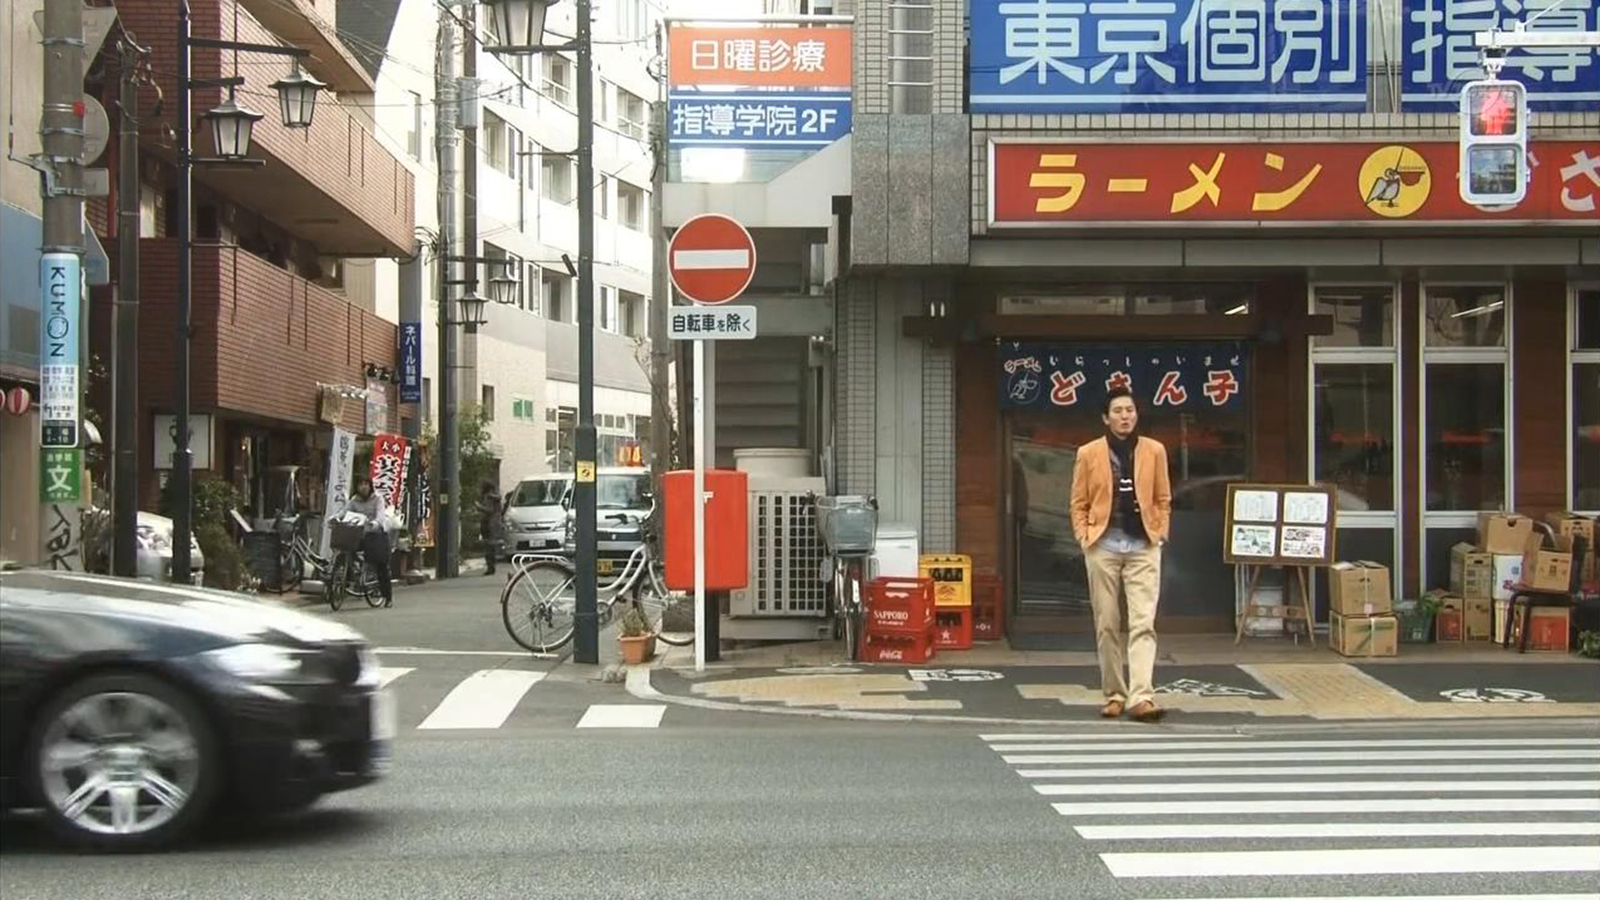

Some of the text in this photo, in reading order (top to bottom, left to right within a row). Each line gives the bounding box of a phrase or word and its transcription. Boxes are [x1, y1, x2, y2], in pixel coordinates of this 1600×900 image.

[692, 39, 826, 72] 日曜診療
[1000, 0, 1357, 84] 東京個別
[673, 104, 837, 136] 指導学院 2F
[1028, 152, 1322, 213] ラーメン
[47, 266, 70, 357] KUMON
[673, 313, 750, 333] 自転車を除く
[47, 464, 73, 492] 文
[873, 609, 909, 620] SAPPORO
